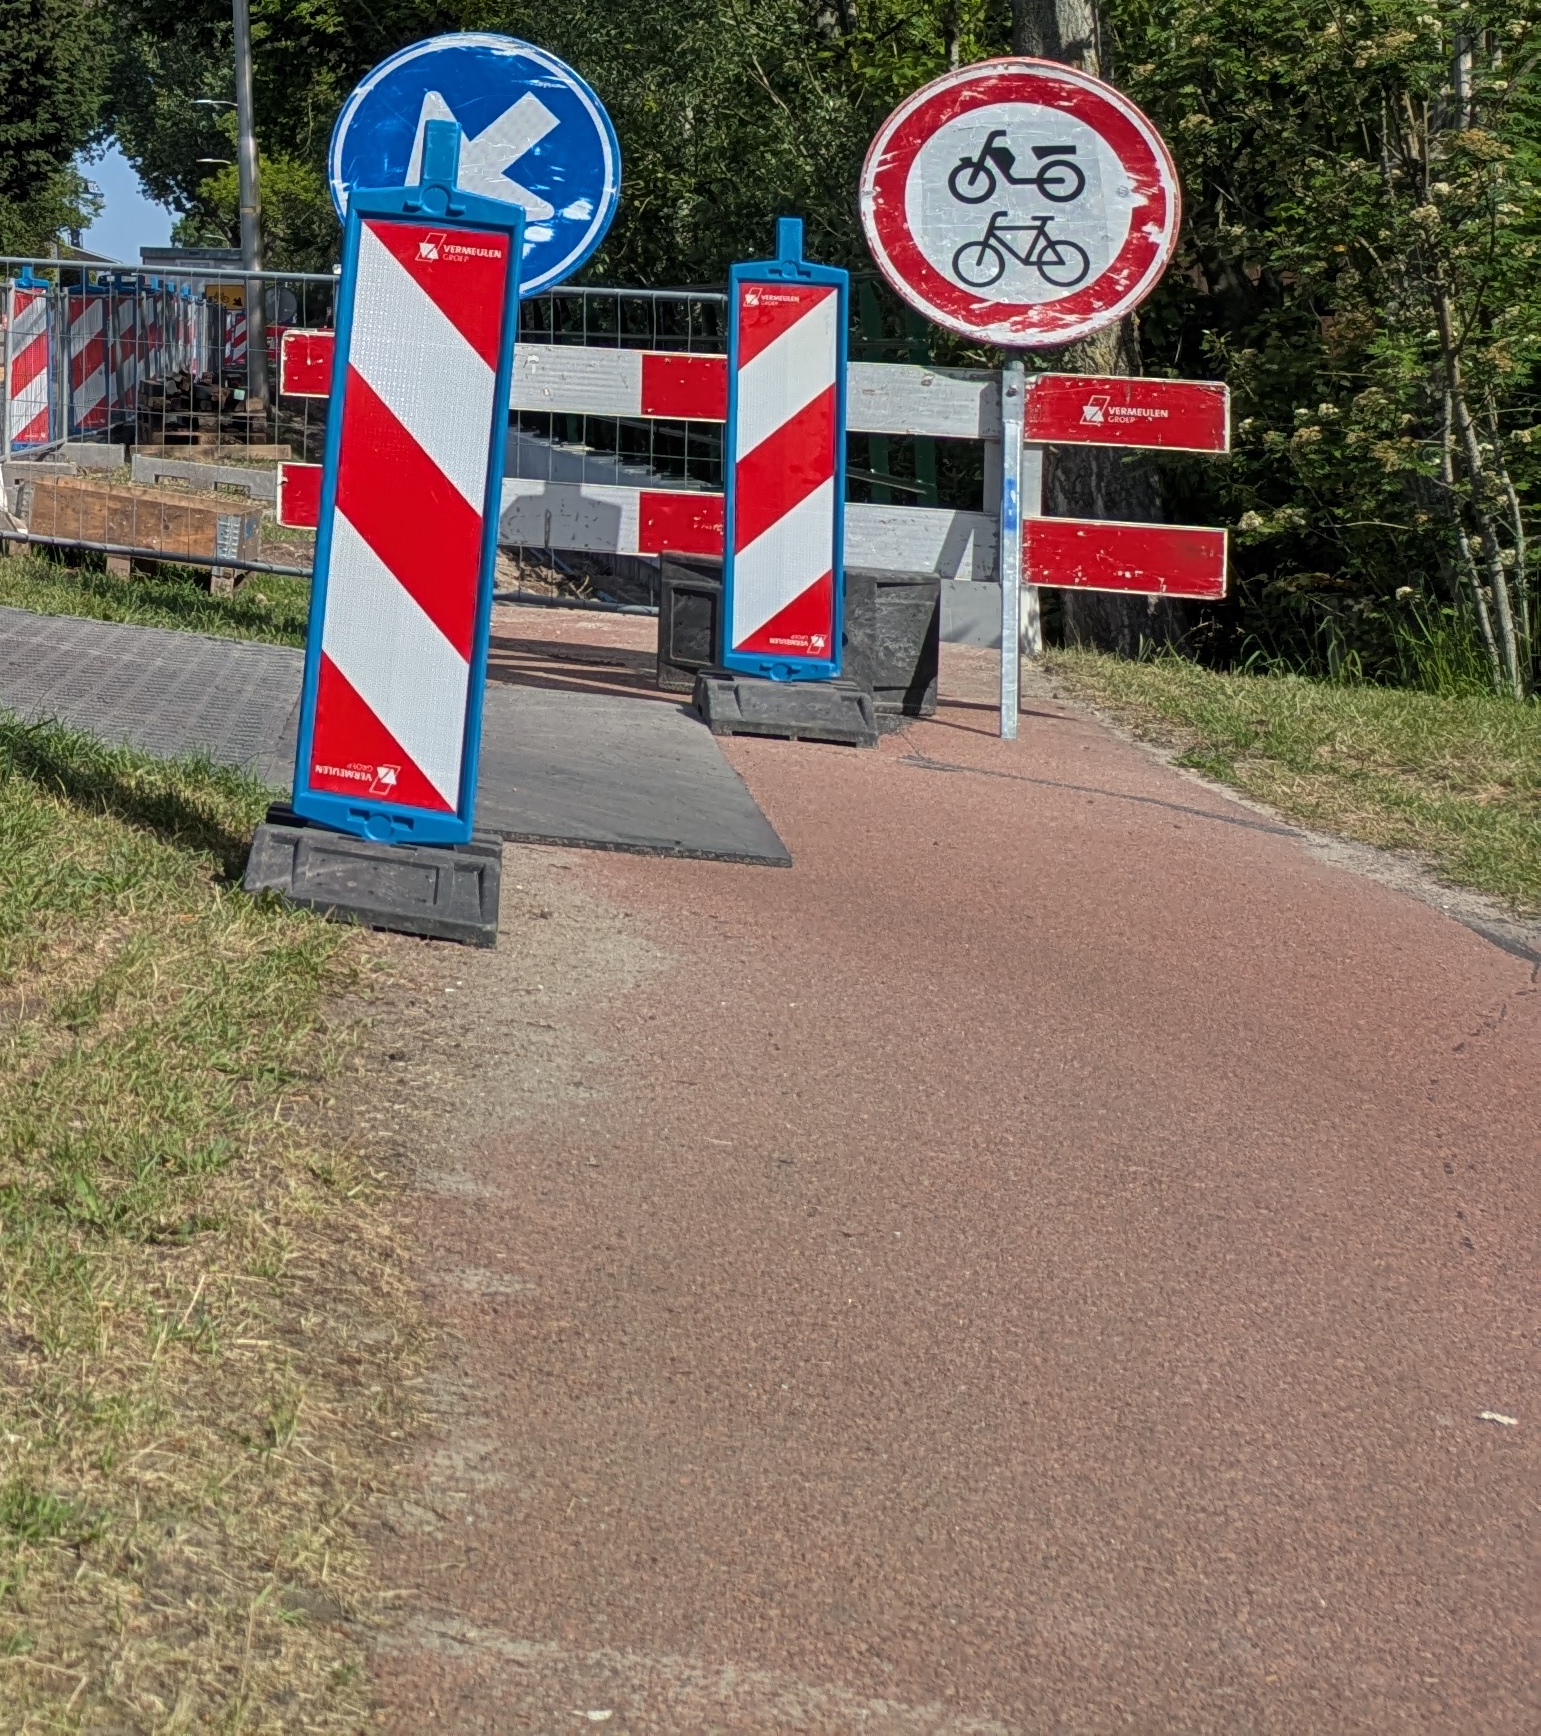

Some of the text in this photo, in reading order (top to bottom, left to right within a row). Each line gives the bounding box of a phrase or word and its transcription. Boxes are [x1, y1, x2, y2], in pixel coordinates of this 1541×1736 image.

[443, 244, 502, 259] VERMEULEN
[1107, 406, 1169, 418] VERMEULEN
[314, 764, 373, 782] VERMEULEN
